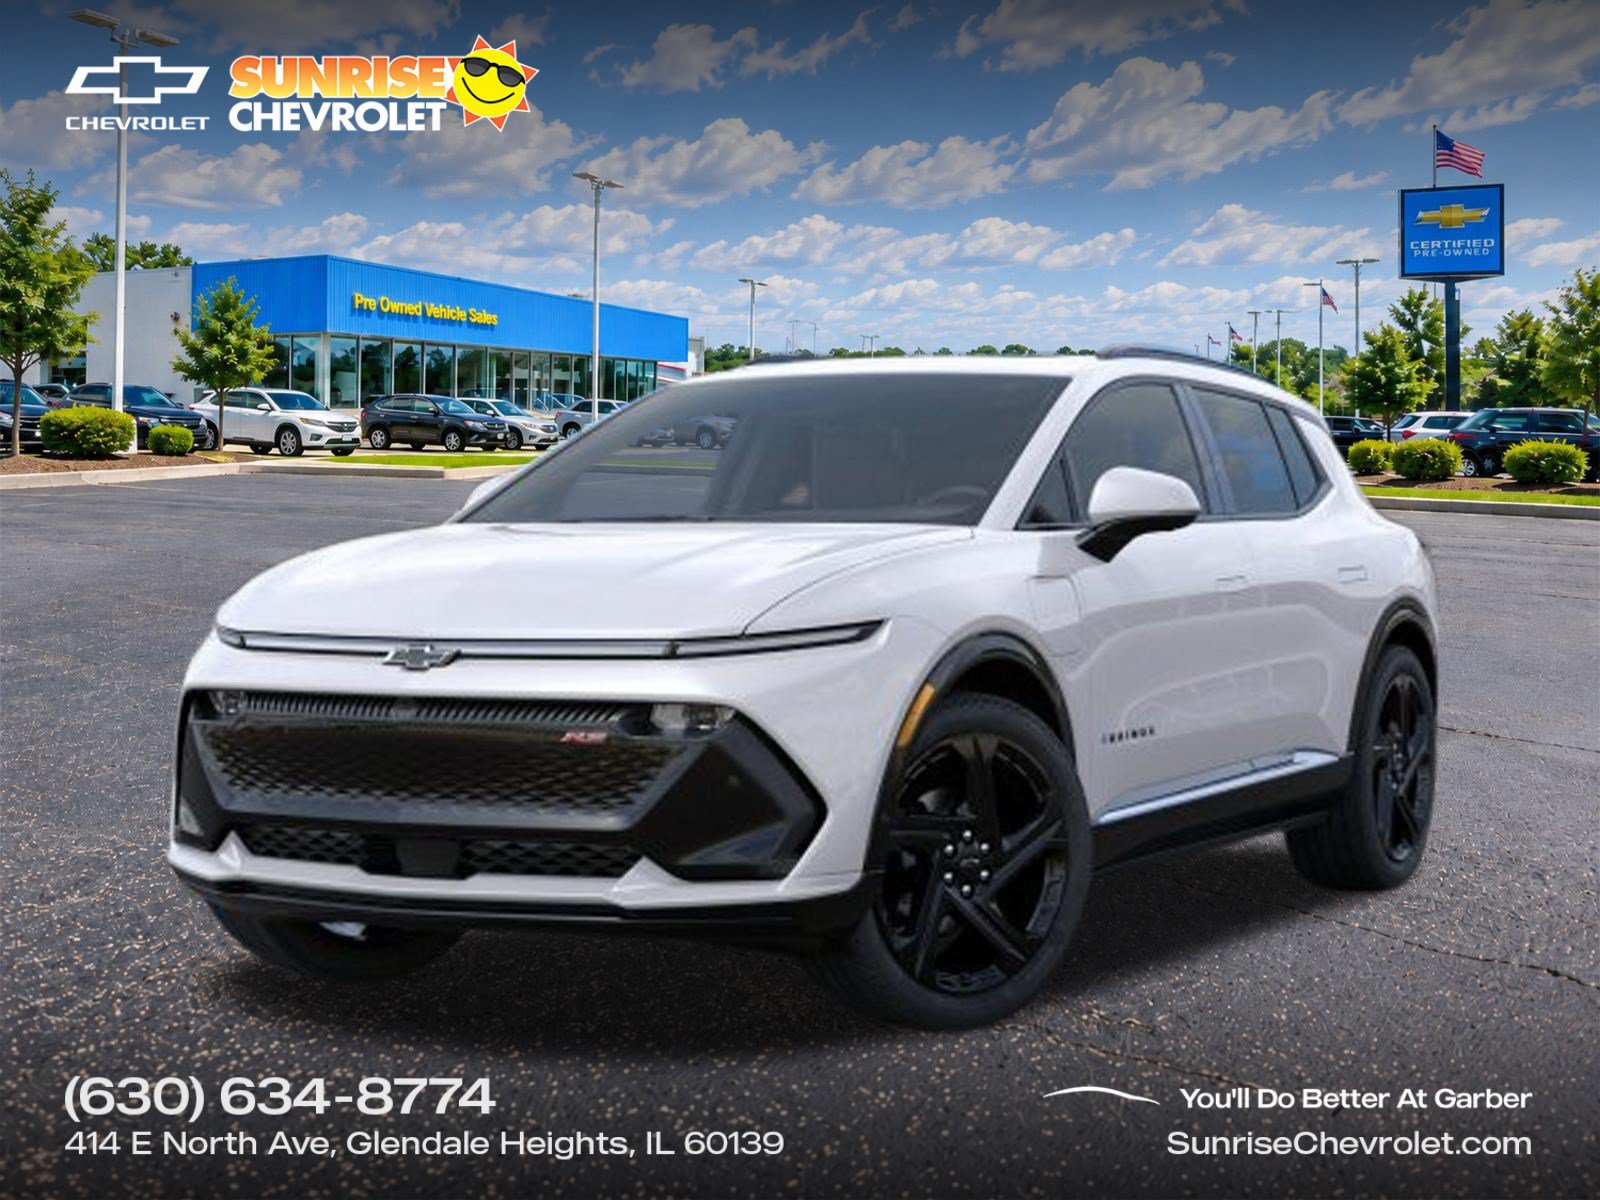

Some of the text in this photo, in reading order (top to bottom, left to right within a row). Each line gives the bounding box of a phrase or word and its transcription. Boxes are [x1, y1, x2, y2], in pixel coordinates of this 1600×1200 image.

[1410, 239, 1495, 249] CERTIFIED
[1414, 248, 1489, 257] PRE-OWNED
[353, 292, 498, 325] Pre Owned Vehicle Sales
